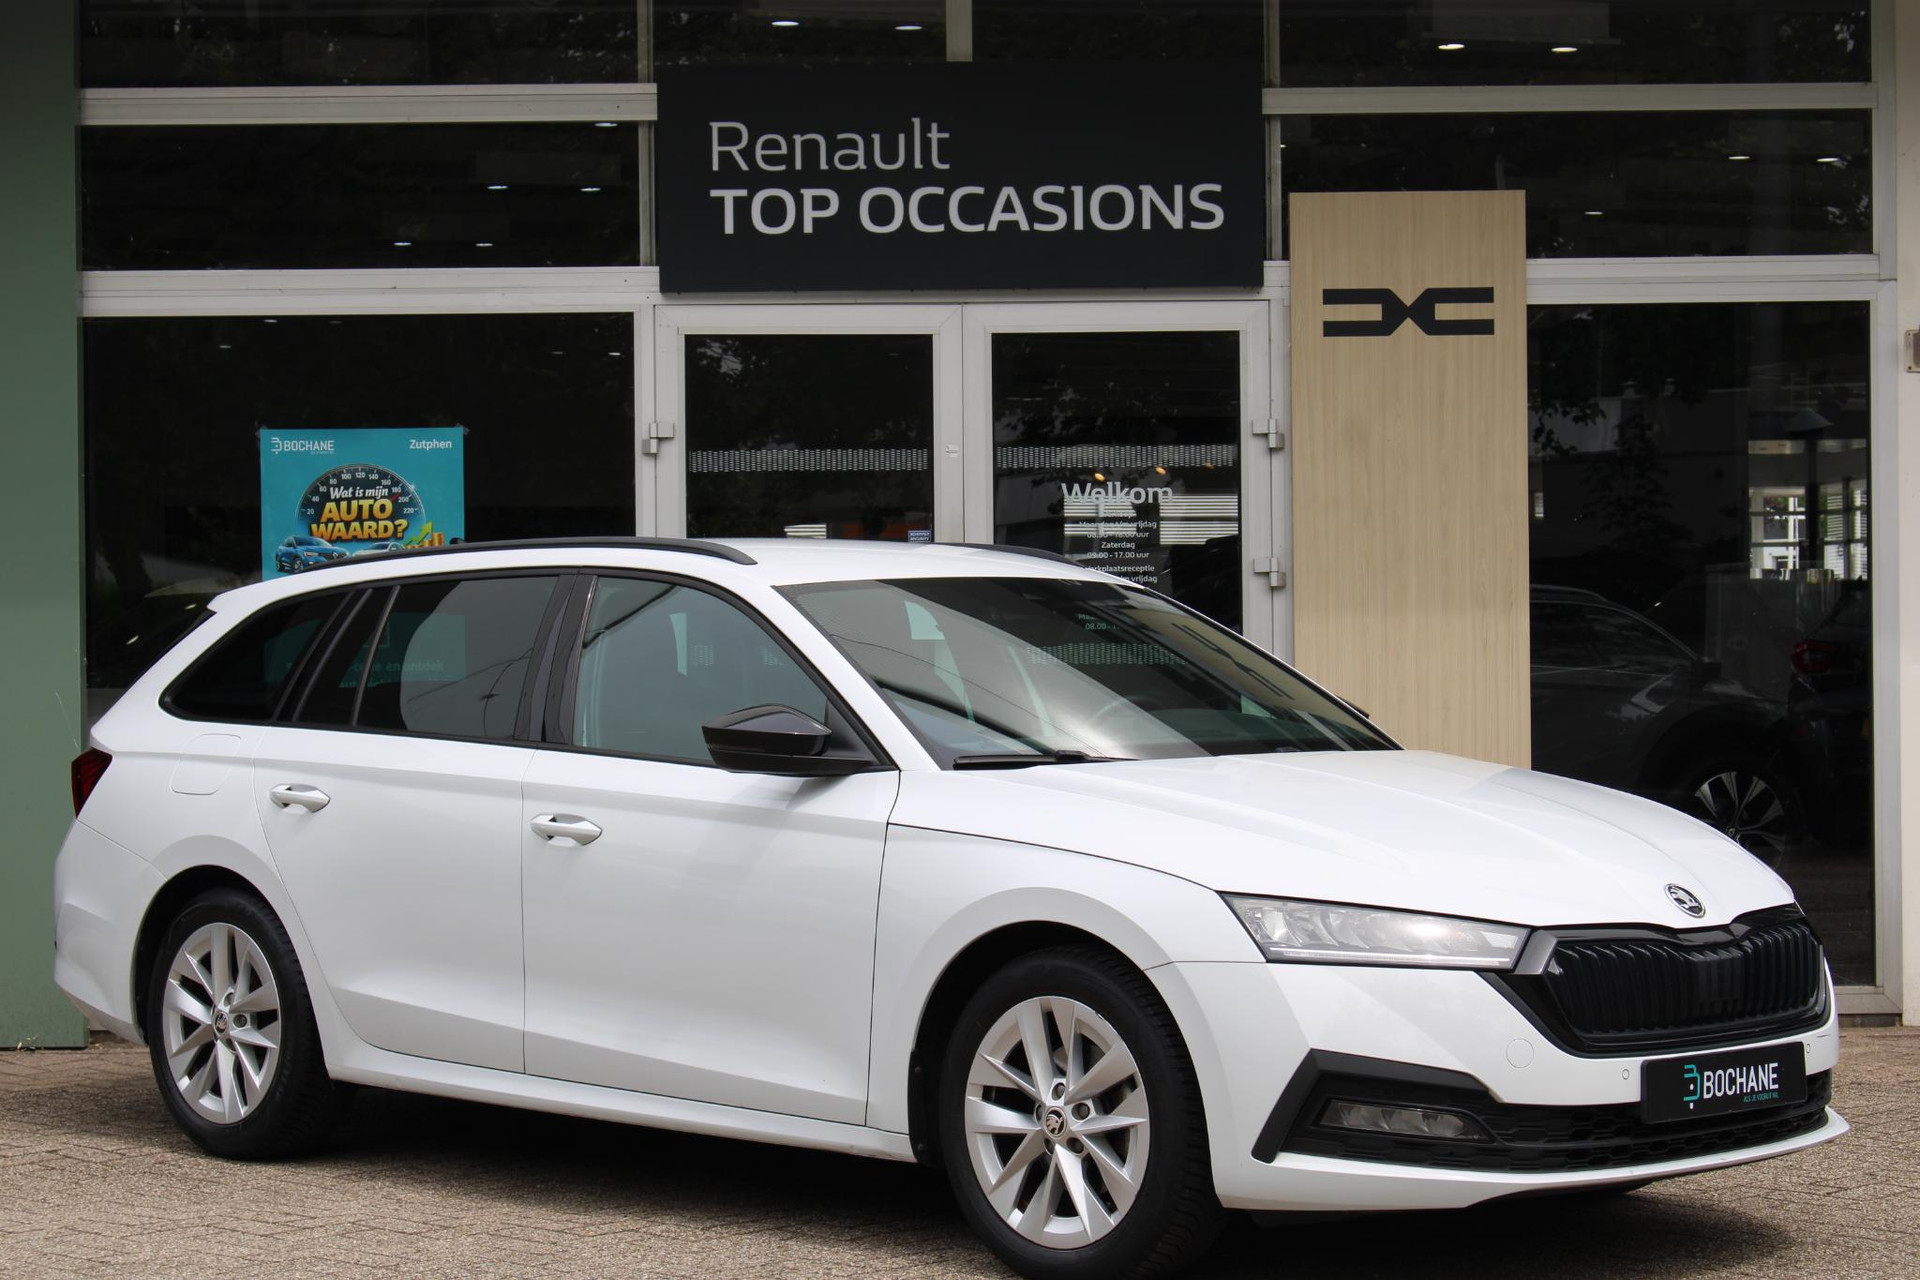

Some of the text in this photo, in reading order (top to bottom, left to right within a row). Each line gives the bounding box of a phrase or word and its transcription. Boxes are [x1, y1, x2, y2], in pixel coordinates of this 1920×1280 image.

[710, 117, 950, 172] Renault
[710, 183, 1225, 235] TOP OCCASIONS
[283, 440, 335, 452] BOCHANE
[409, 439, 452, 451] Zutphen
[330, 485, 388, 500] Wat is mijn
[1061, 481, 1173, 505] Welkom
[320, 498, 393, 523] AUTO
[311, 518, 409, 541] WAARD?
[1101, 541, 1135, 550] Zaterdag
[1131, 575, 1158, 584] vrijdag
[1703, 1062, 1779, 1100] BOCHANE
